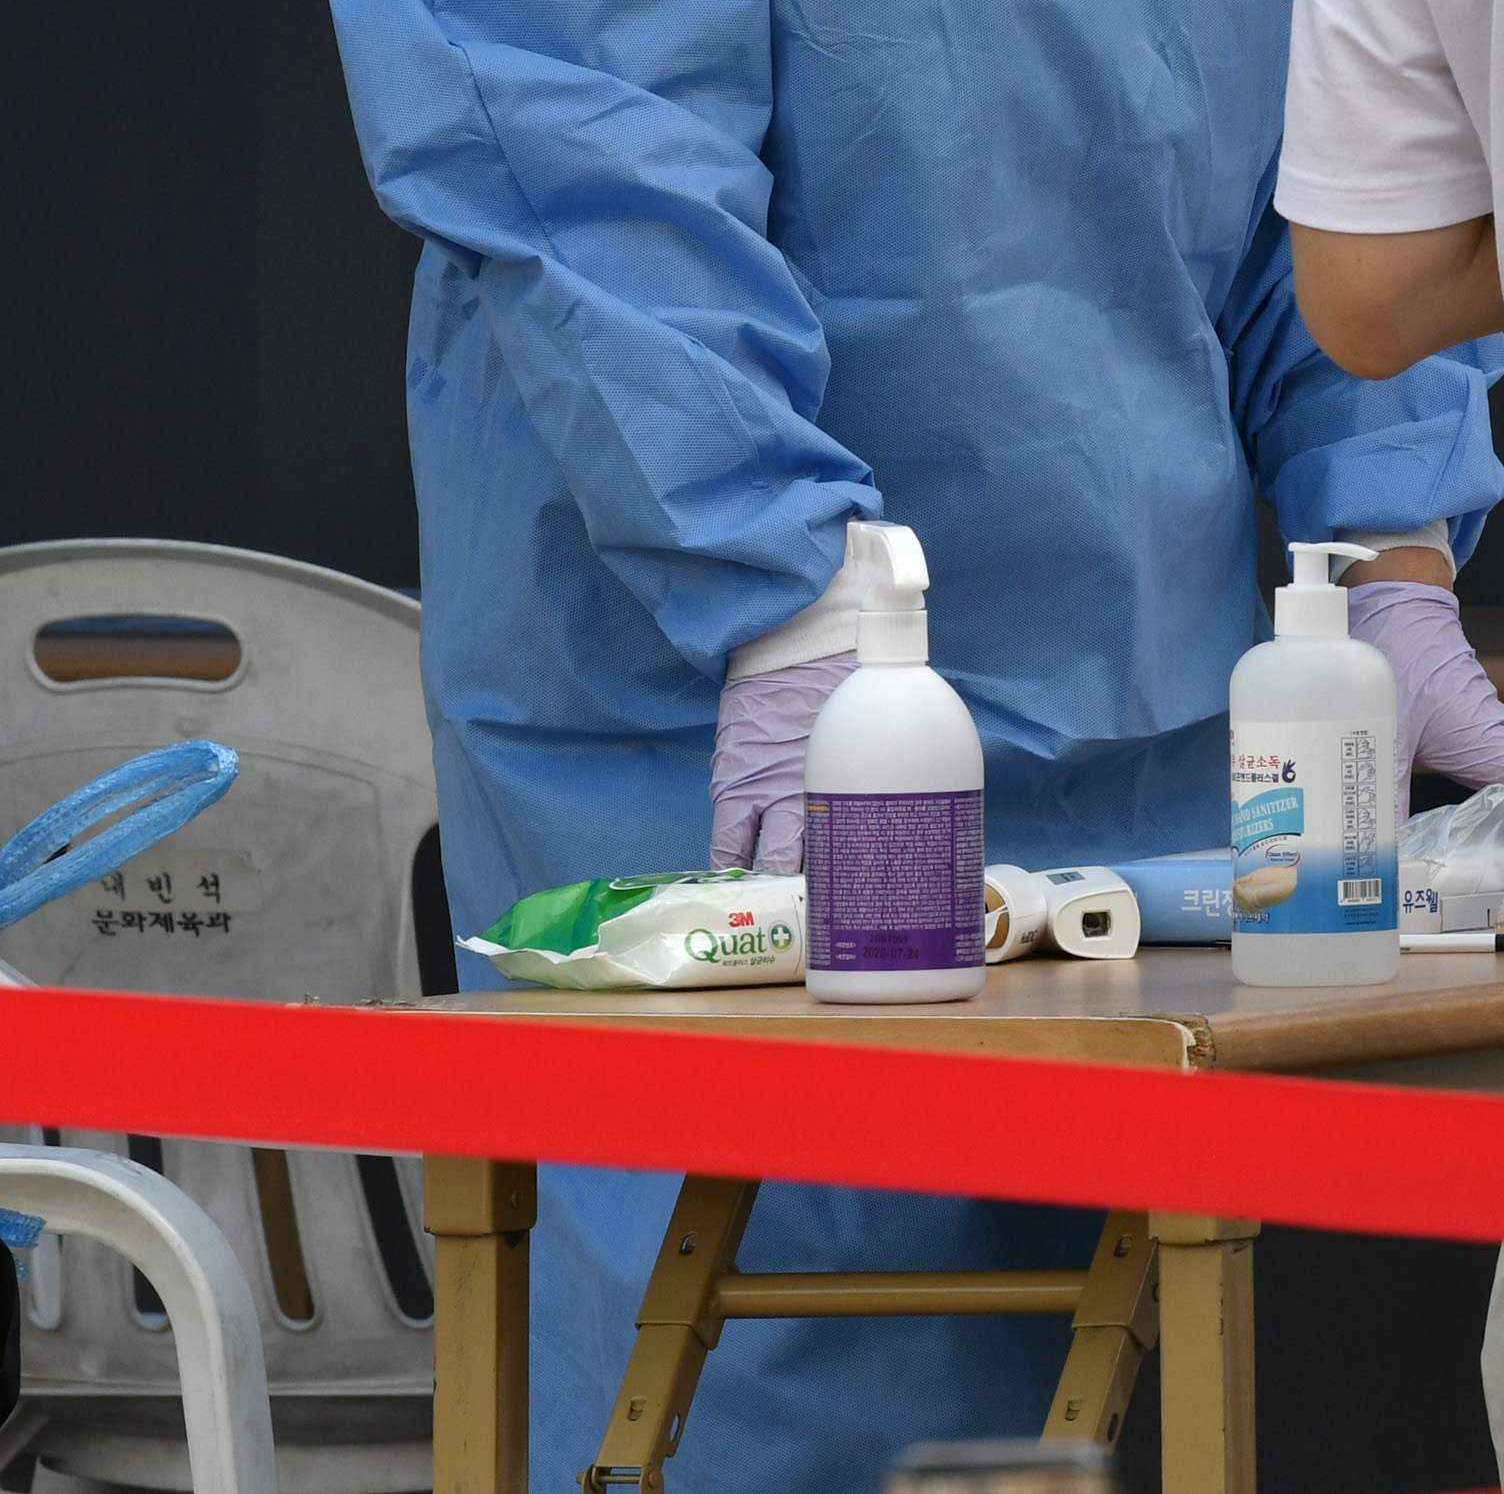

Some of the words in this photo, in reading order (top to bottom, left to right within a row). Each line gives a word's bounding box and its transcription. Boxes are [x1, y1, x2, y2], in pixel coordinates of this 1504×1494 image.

[197, 872, 222, 904] 석
[728, 911, 755, 928] 3M
[684, 926, 768, 963] Quat
